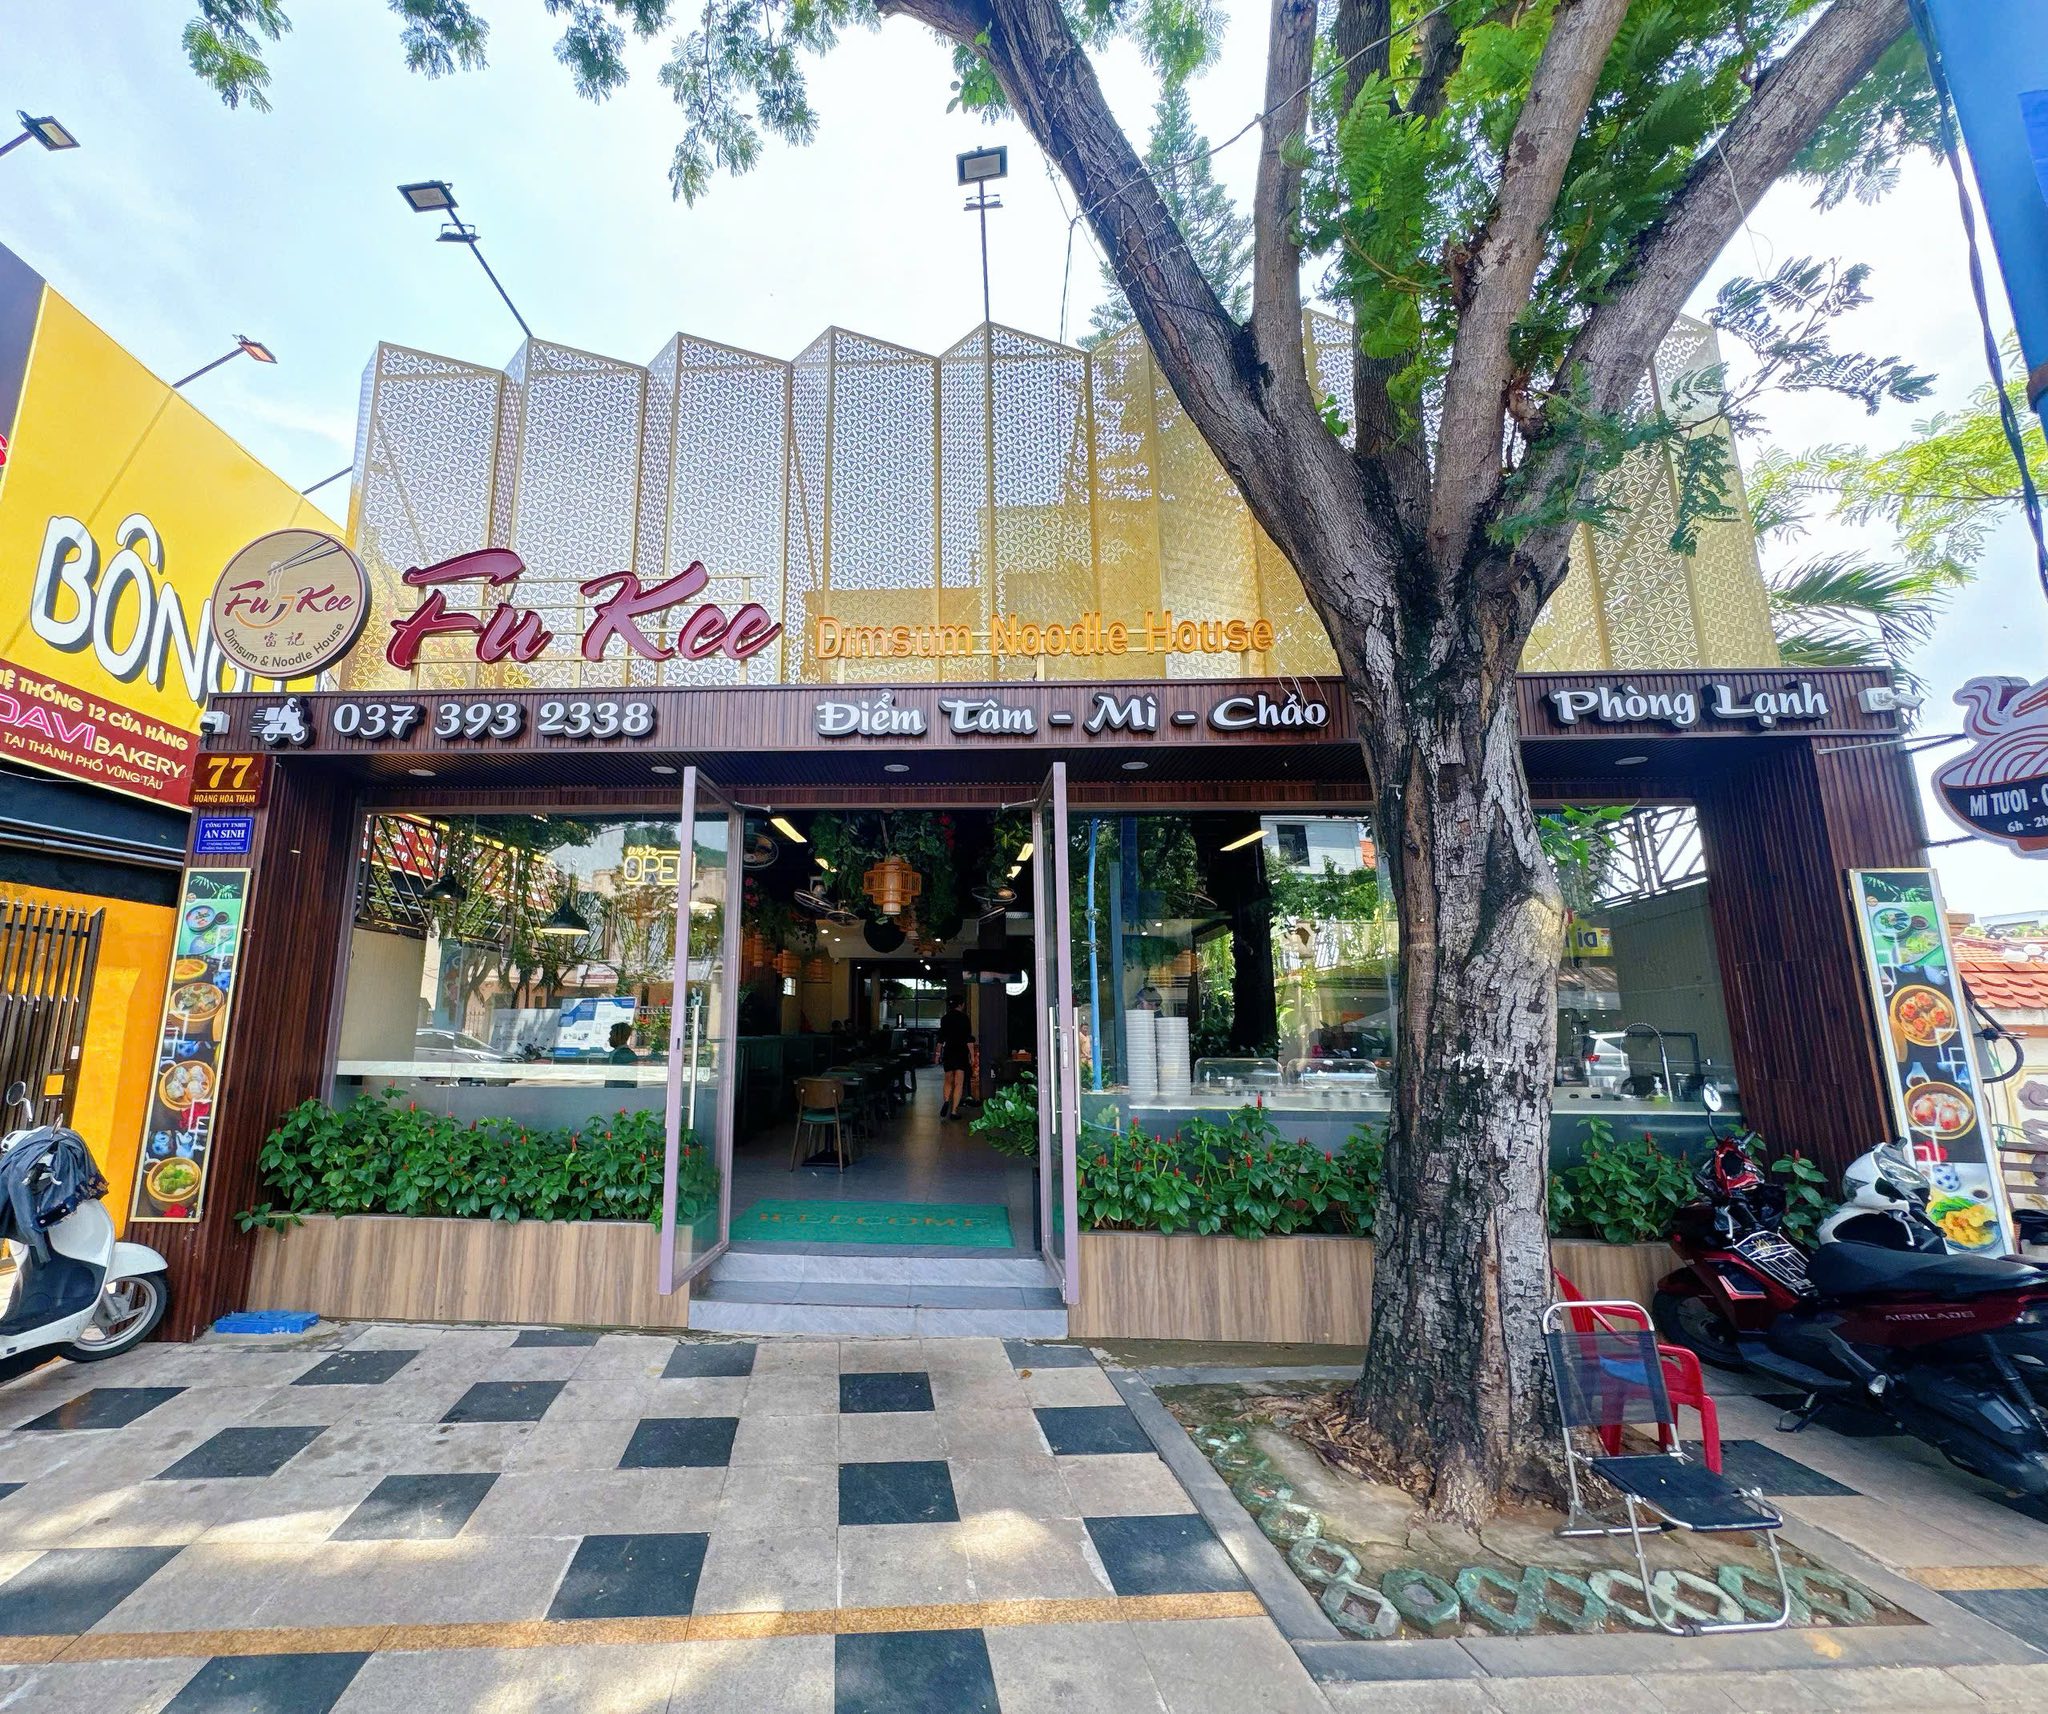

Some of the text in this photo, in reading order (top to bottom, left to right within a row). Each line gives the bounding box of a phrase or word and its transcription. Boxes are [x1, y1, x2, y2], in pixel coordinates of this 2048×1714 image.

[224, 580, 355, 616] Fu Kee
[387, 548, 783, 670] Fu Kee
[224, 622, 345, 667] Dimsum & Noodle House
[991, 612, 1128, 657] Noodle
[1145, 610, 1274, 655] House
[20, 677, 83, 712] THỐNG
[88, 703, 107, 722] 12
[109, 712, 142, 736] CỬA
[145, 725, 189, 750] HÀNG
[334, 701, 650, 735] 037 393 2338
[816, 693, 924, 732] Điểm
[941, 698, 1035, 730] Tâm
[1088, 695, 1157, 729] Mì
[1554, 682, 1829, 724] Phòng Lạnh
[4, 732, 163, 790] TẠI THÀNH PHỐ VŨNG TÀU
[208, 757, 253, 788] 77
[1970, 789, 1988, 816] MÌ
[204, 829, 245, 838] AN SINH
[2007, 821, 2024, 832] 6h
[624, 856, 690, 882] OPE
